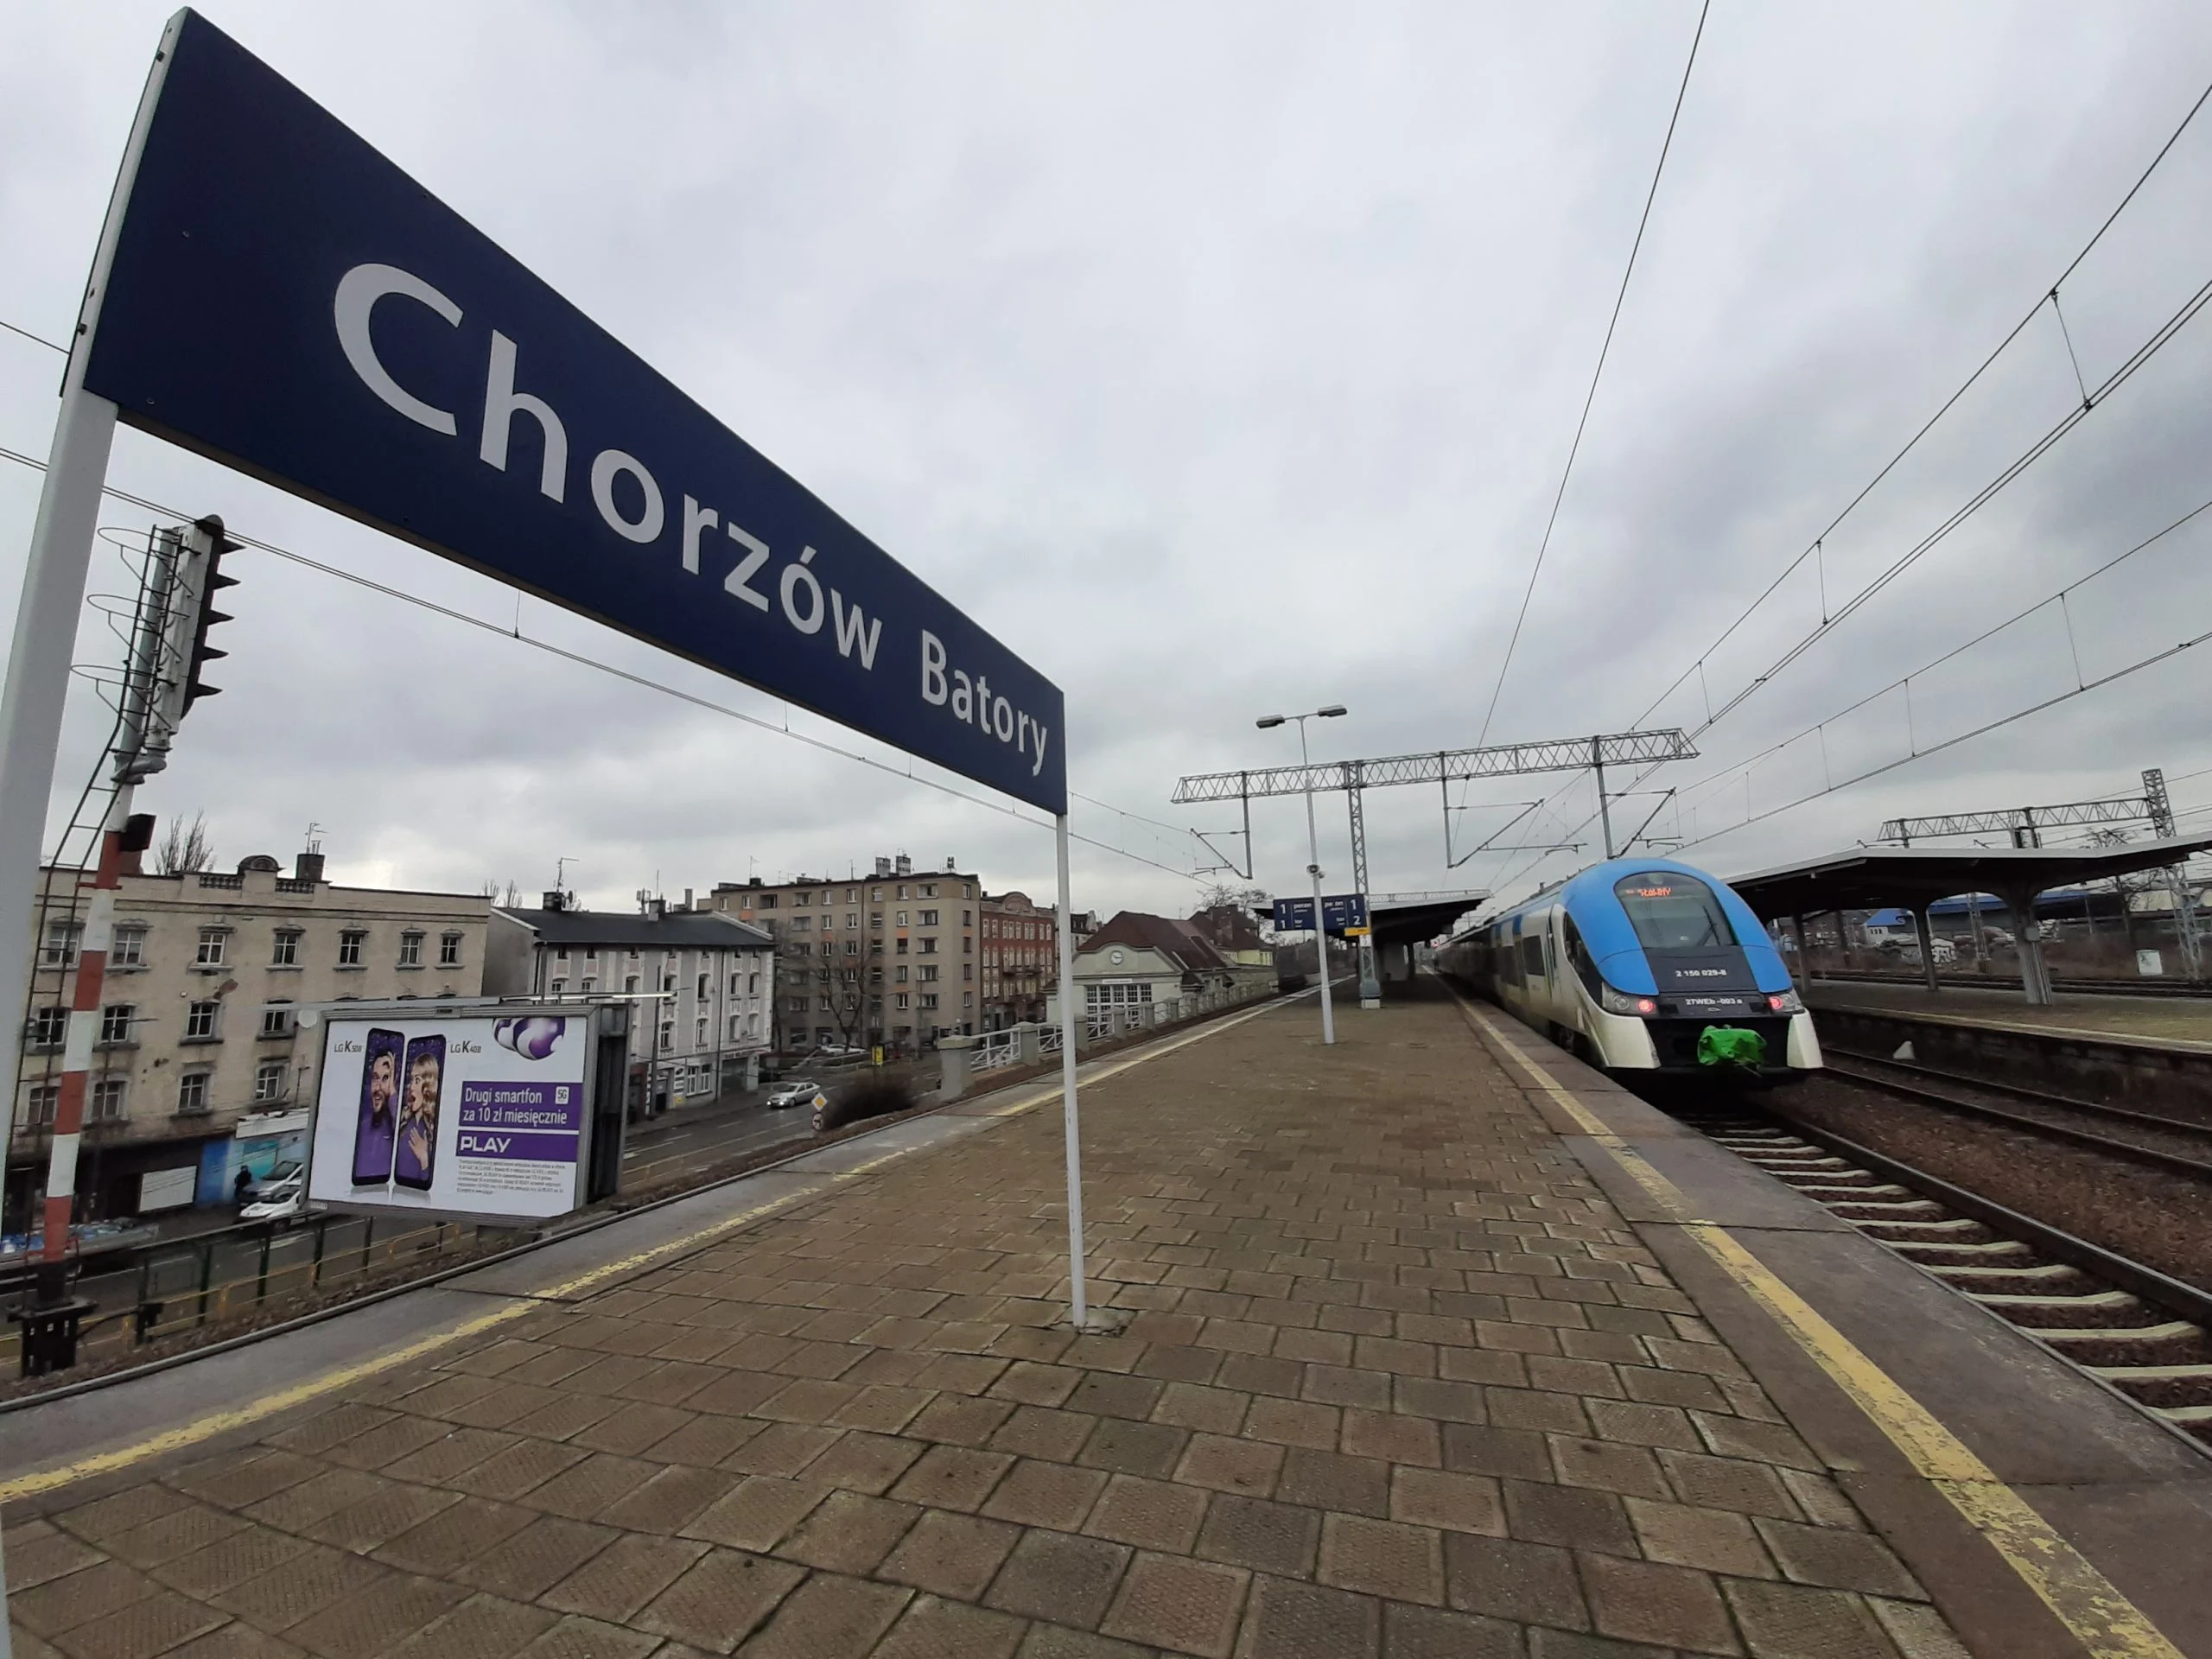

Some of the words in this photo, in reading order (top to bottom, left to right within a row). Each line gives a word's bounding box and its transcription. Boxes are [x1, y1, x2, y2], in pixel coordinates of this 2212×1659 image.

[334, 263, 883, 671] Chorzów
[920, 630, 1048, 776] Batory
[1280, 904, 1287, 914] 1
[1351, 899, 1357, 911] 1
[1281, 919, 1286, 929] 1
[1353, 915, 1361, 925] 2
[334, 1043, 344, 1052] LG
[450, 1044, 461, 1053] LG
[465, 1087, 493, 1107] Drugi
[494, 1087, 543, 1104] smartfon
[557, 1089, 568, 1100] 5G
[462, 1109, 475, 1122] za
[478, 1107, 491, 1122] 10
[493, 1106, 503, 1122] zł
[504, 1108, 568, 1128] miesięcznie
[460, 1135, 512, 1154] PLAY
